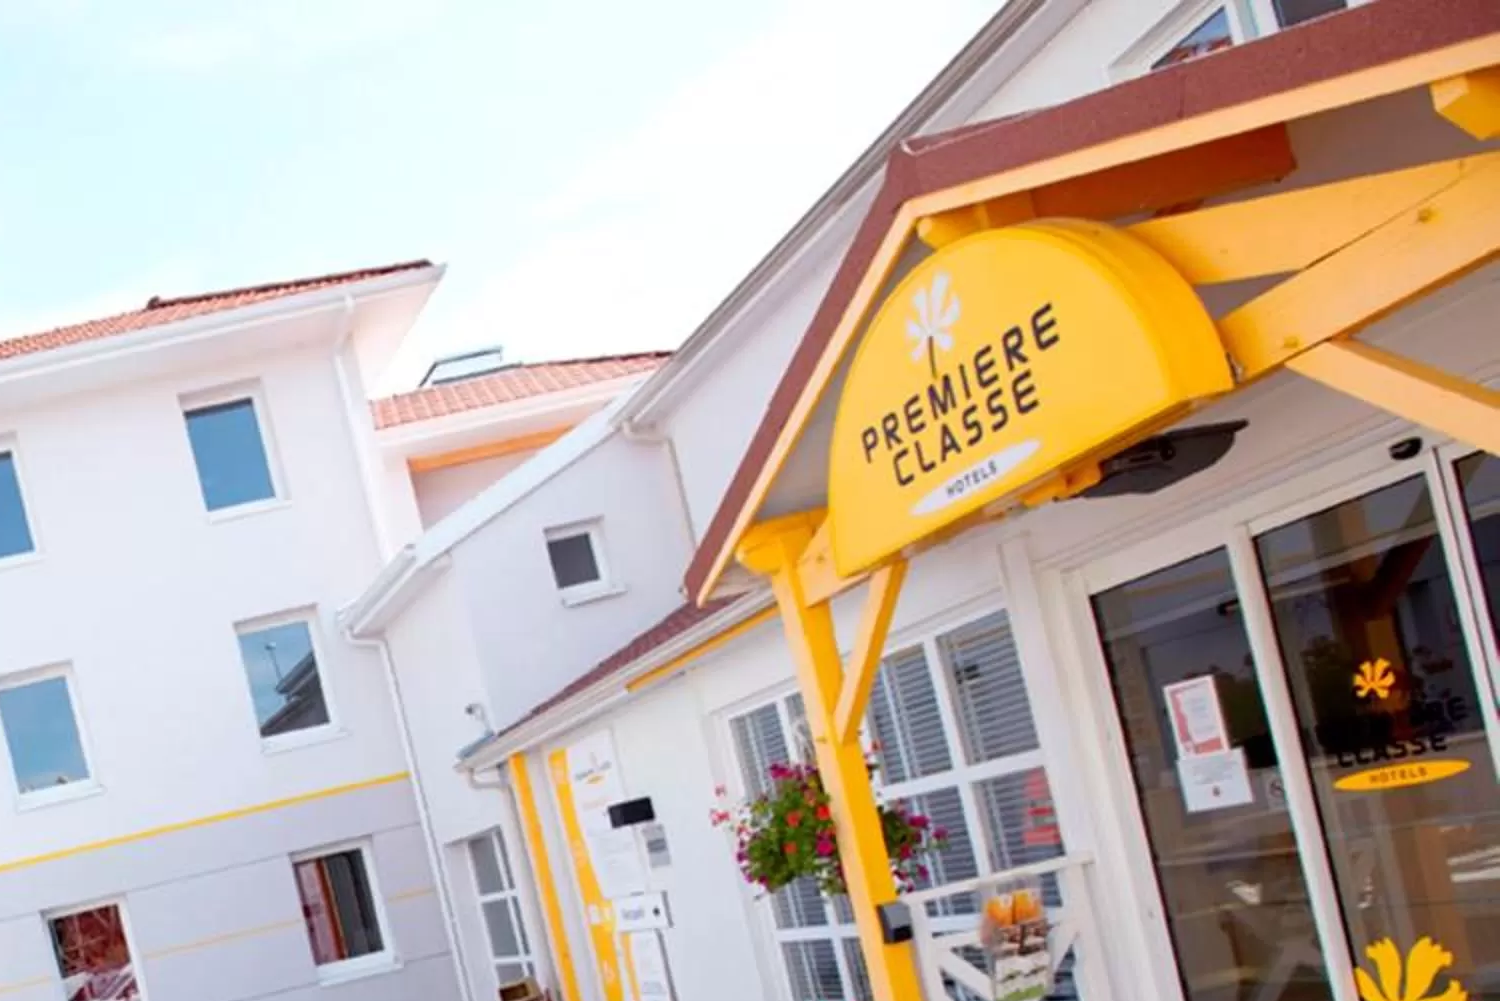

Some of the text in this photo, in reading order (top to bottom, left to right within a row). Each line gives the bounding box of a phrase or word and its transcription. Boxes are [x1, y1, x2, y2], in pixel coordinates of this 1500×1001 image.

[861, 303, 1060, 464] PREMIERE
[892, 371, 1040, 487] CLASSE
[946, 460, 998, 497] HOTELS
[1369, 765, 1428, 784] HOTELS
